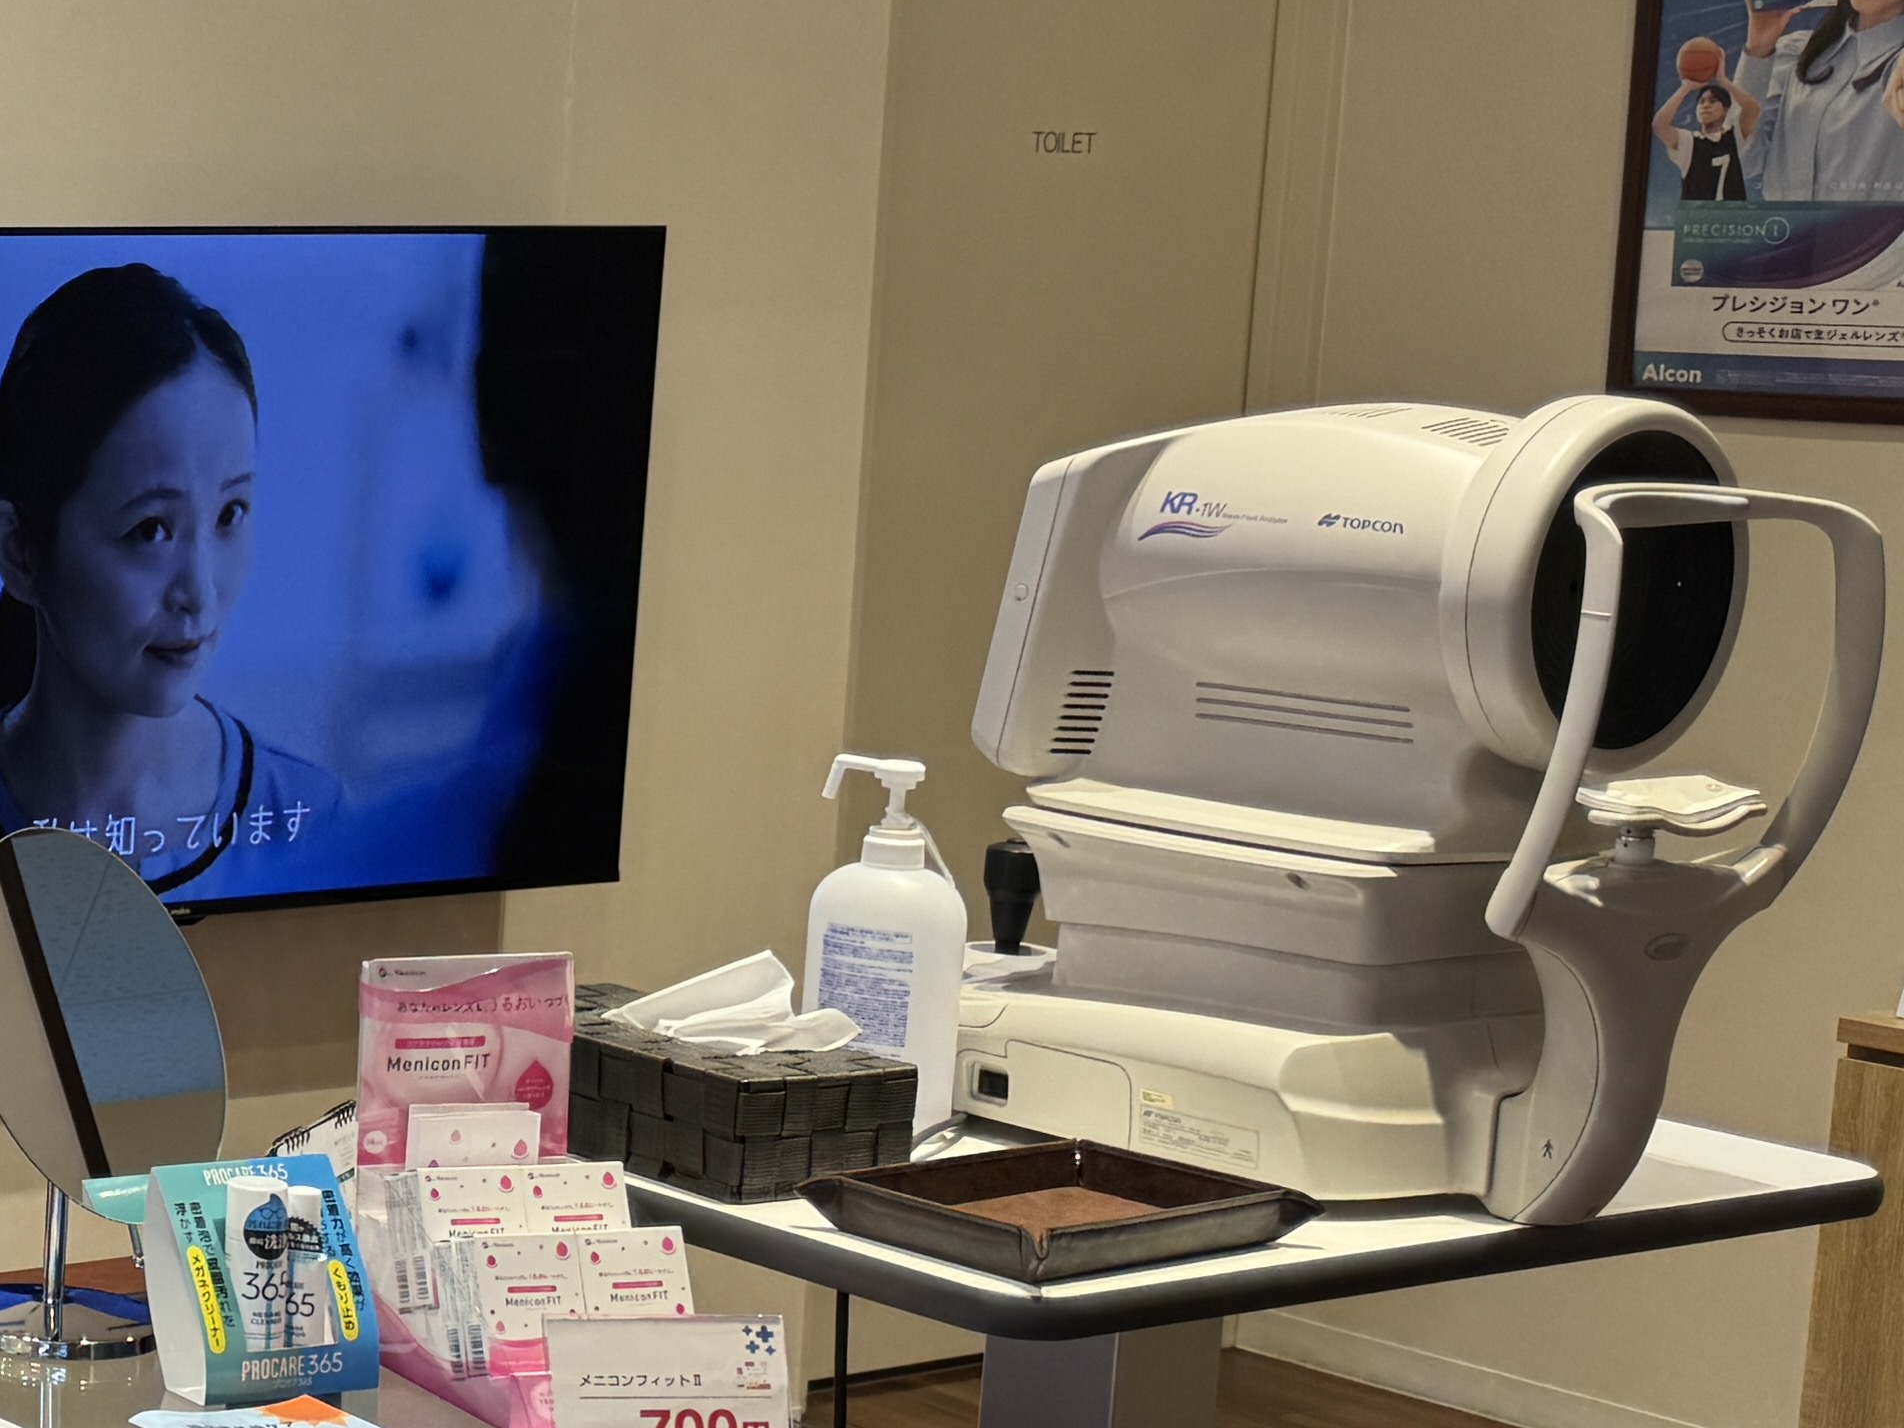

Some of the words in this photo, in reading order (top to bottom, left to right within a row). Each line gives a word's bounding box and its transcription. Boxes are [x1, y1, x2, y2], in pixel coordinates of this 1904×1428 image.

[1032, 130, 1098, 156] TOILET
[1711, 153, 1732, 201] 7
[1711, 295, 1826, 315] プレシジョン
[1642, 363, 1702, 384] Alcon
[1342, 516, 1405, 536] TOPCON
[191, 1254, 222, 1347] メガネクリーナー
[332, 1268, 355, 1331] くもり止め
